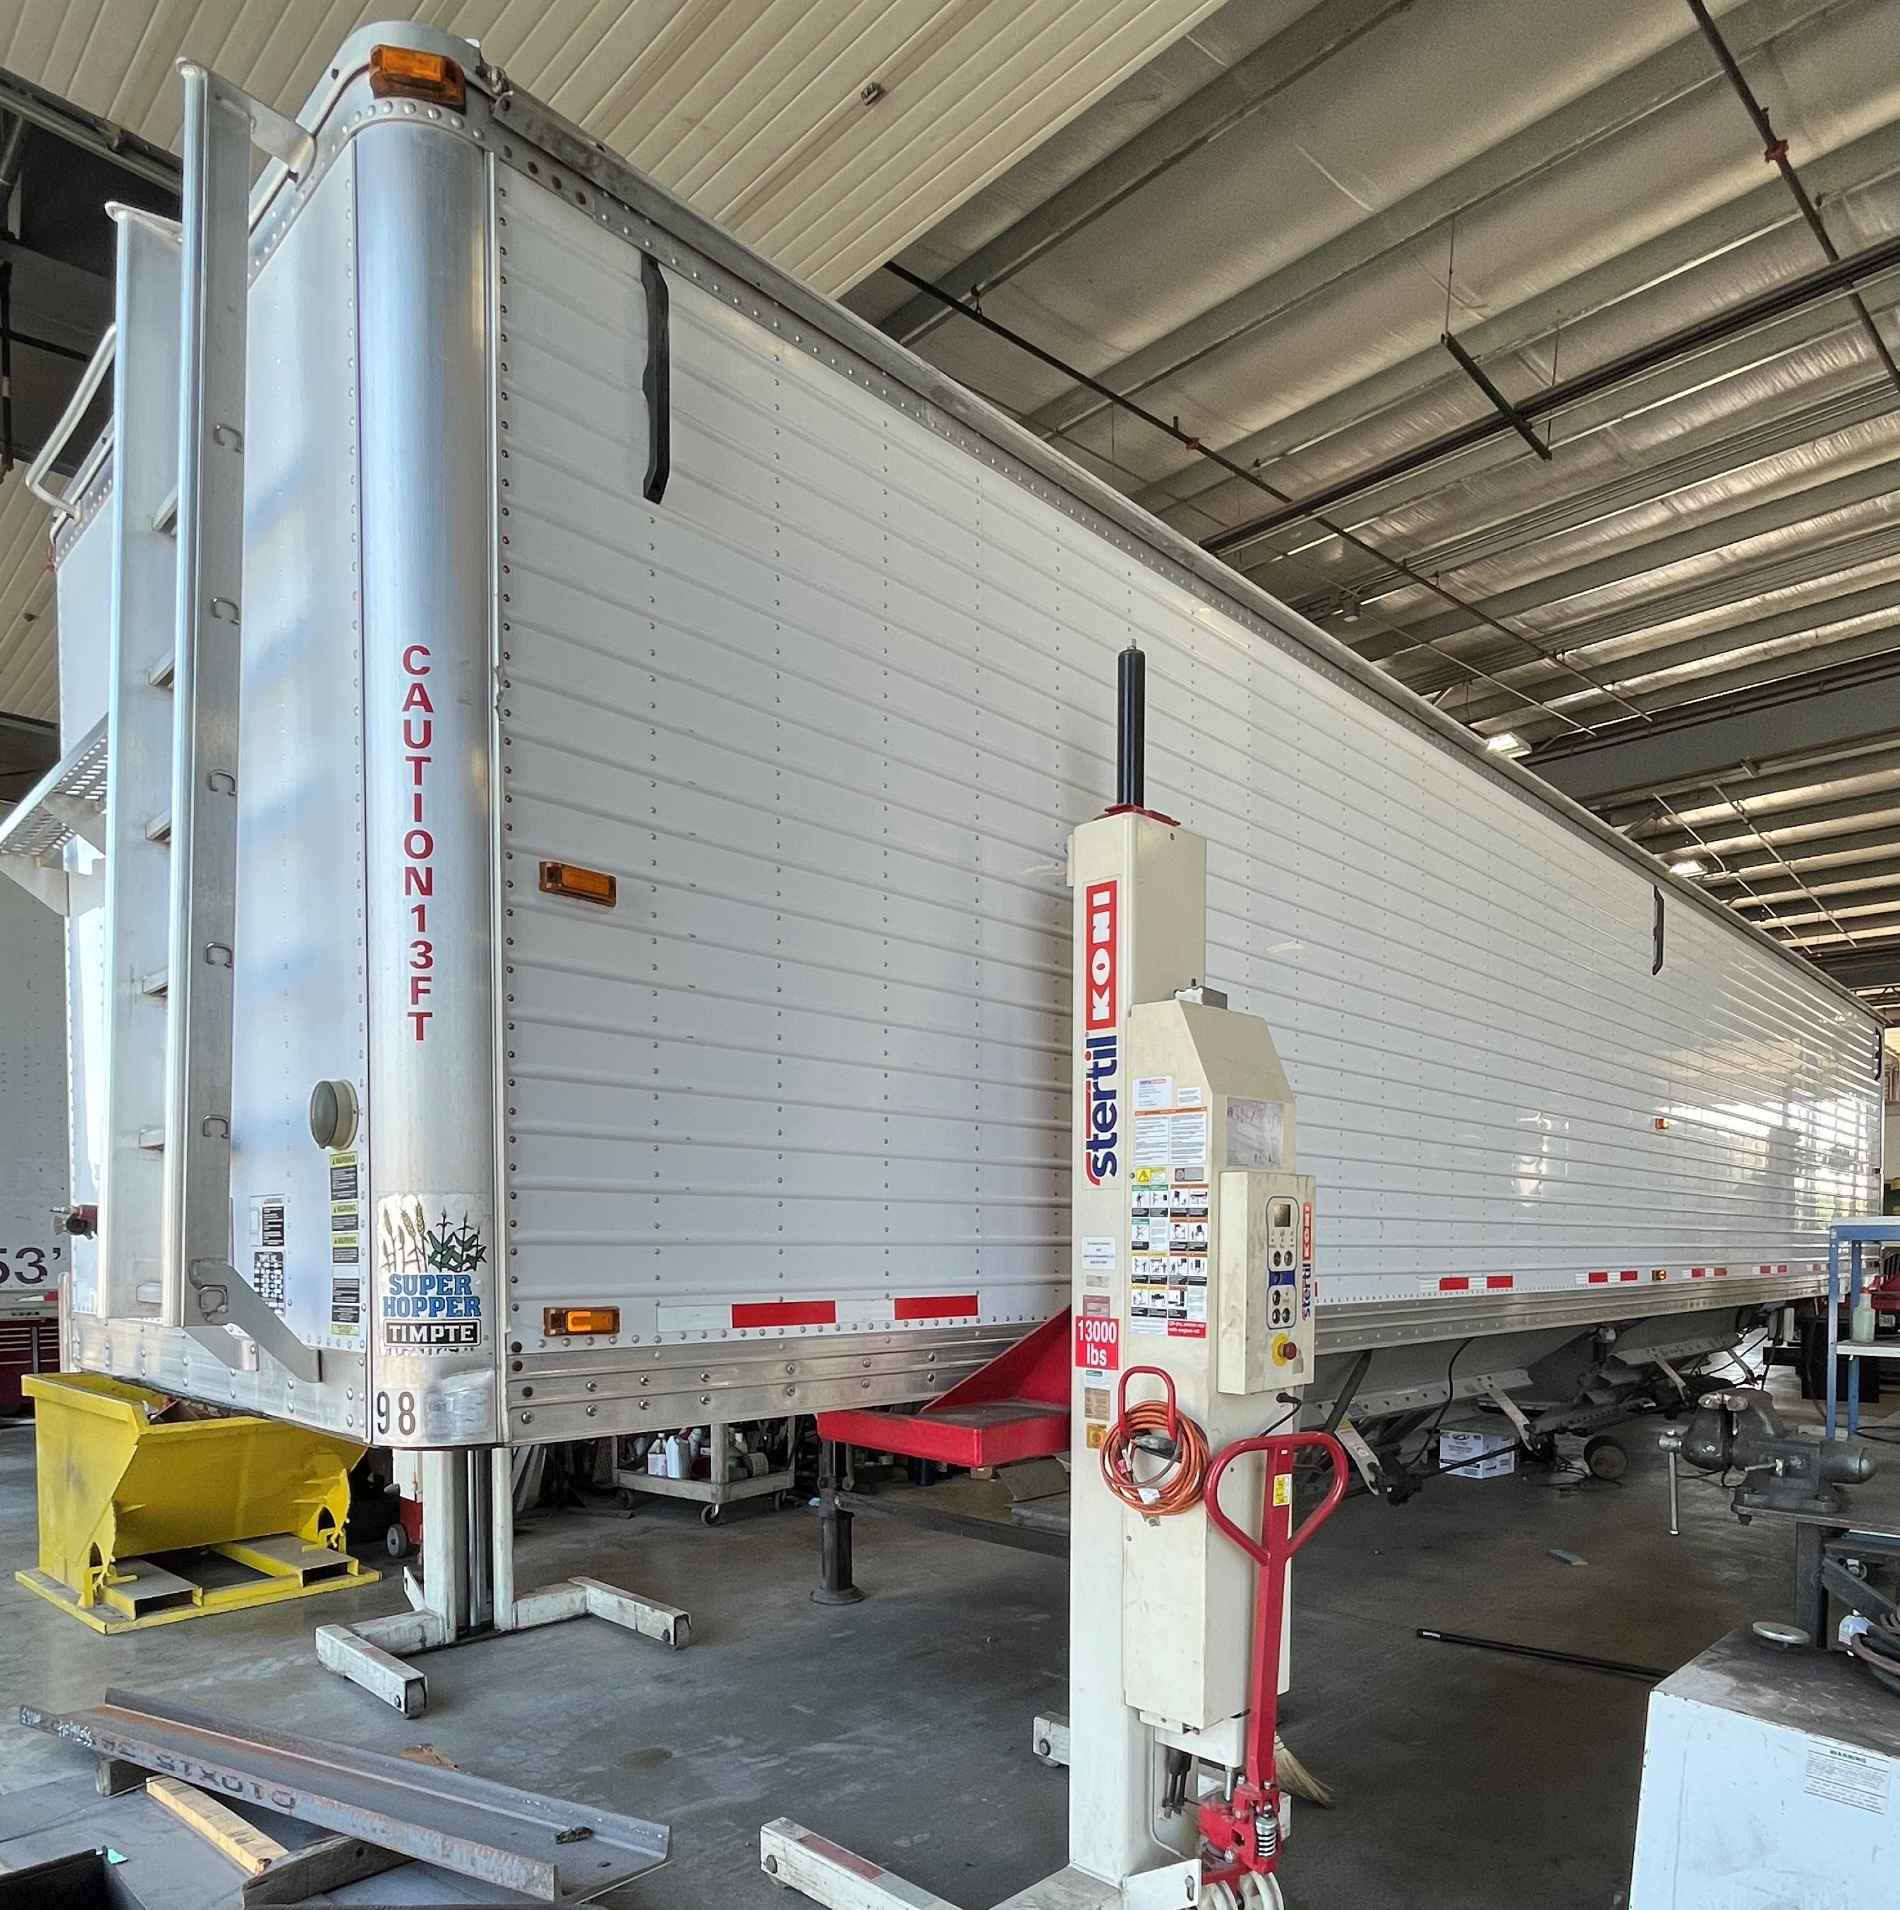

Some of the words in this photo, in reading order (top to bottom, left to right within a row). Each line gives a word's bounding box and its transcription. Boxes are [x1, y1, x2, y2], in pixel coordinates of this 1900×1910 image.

[1090, 890, 1112, 1021] KONI
[1085, 1034, 1118, 1186] stertil
[0, 1247, 61, 1286] 3'
[389, 1273, 473, 1295] SUPER
[383, 1295, 482, 1317] HOPPER
[388, 1324, 474, 1342] TIMPTE
[1077, 1319, 1117, 1344] 13000
[1086, 1343, 1108, 1366] lbs
[376, 1391, 416, 1436] 98
